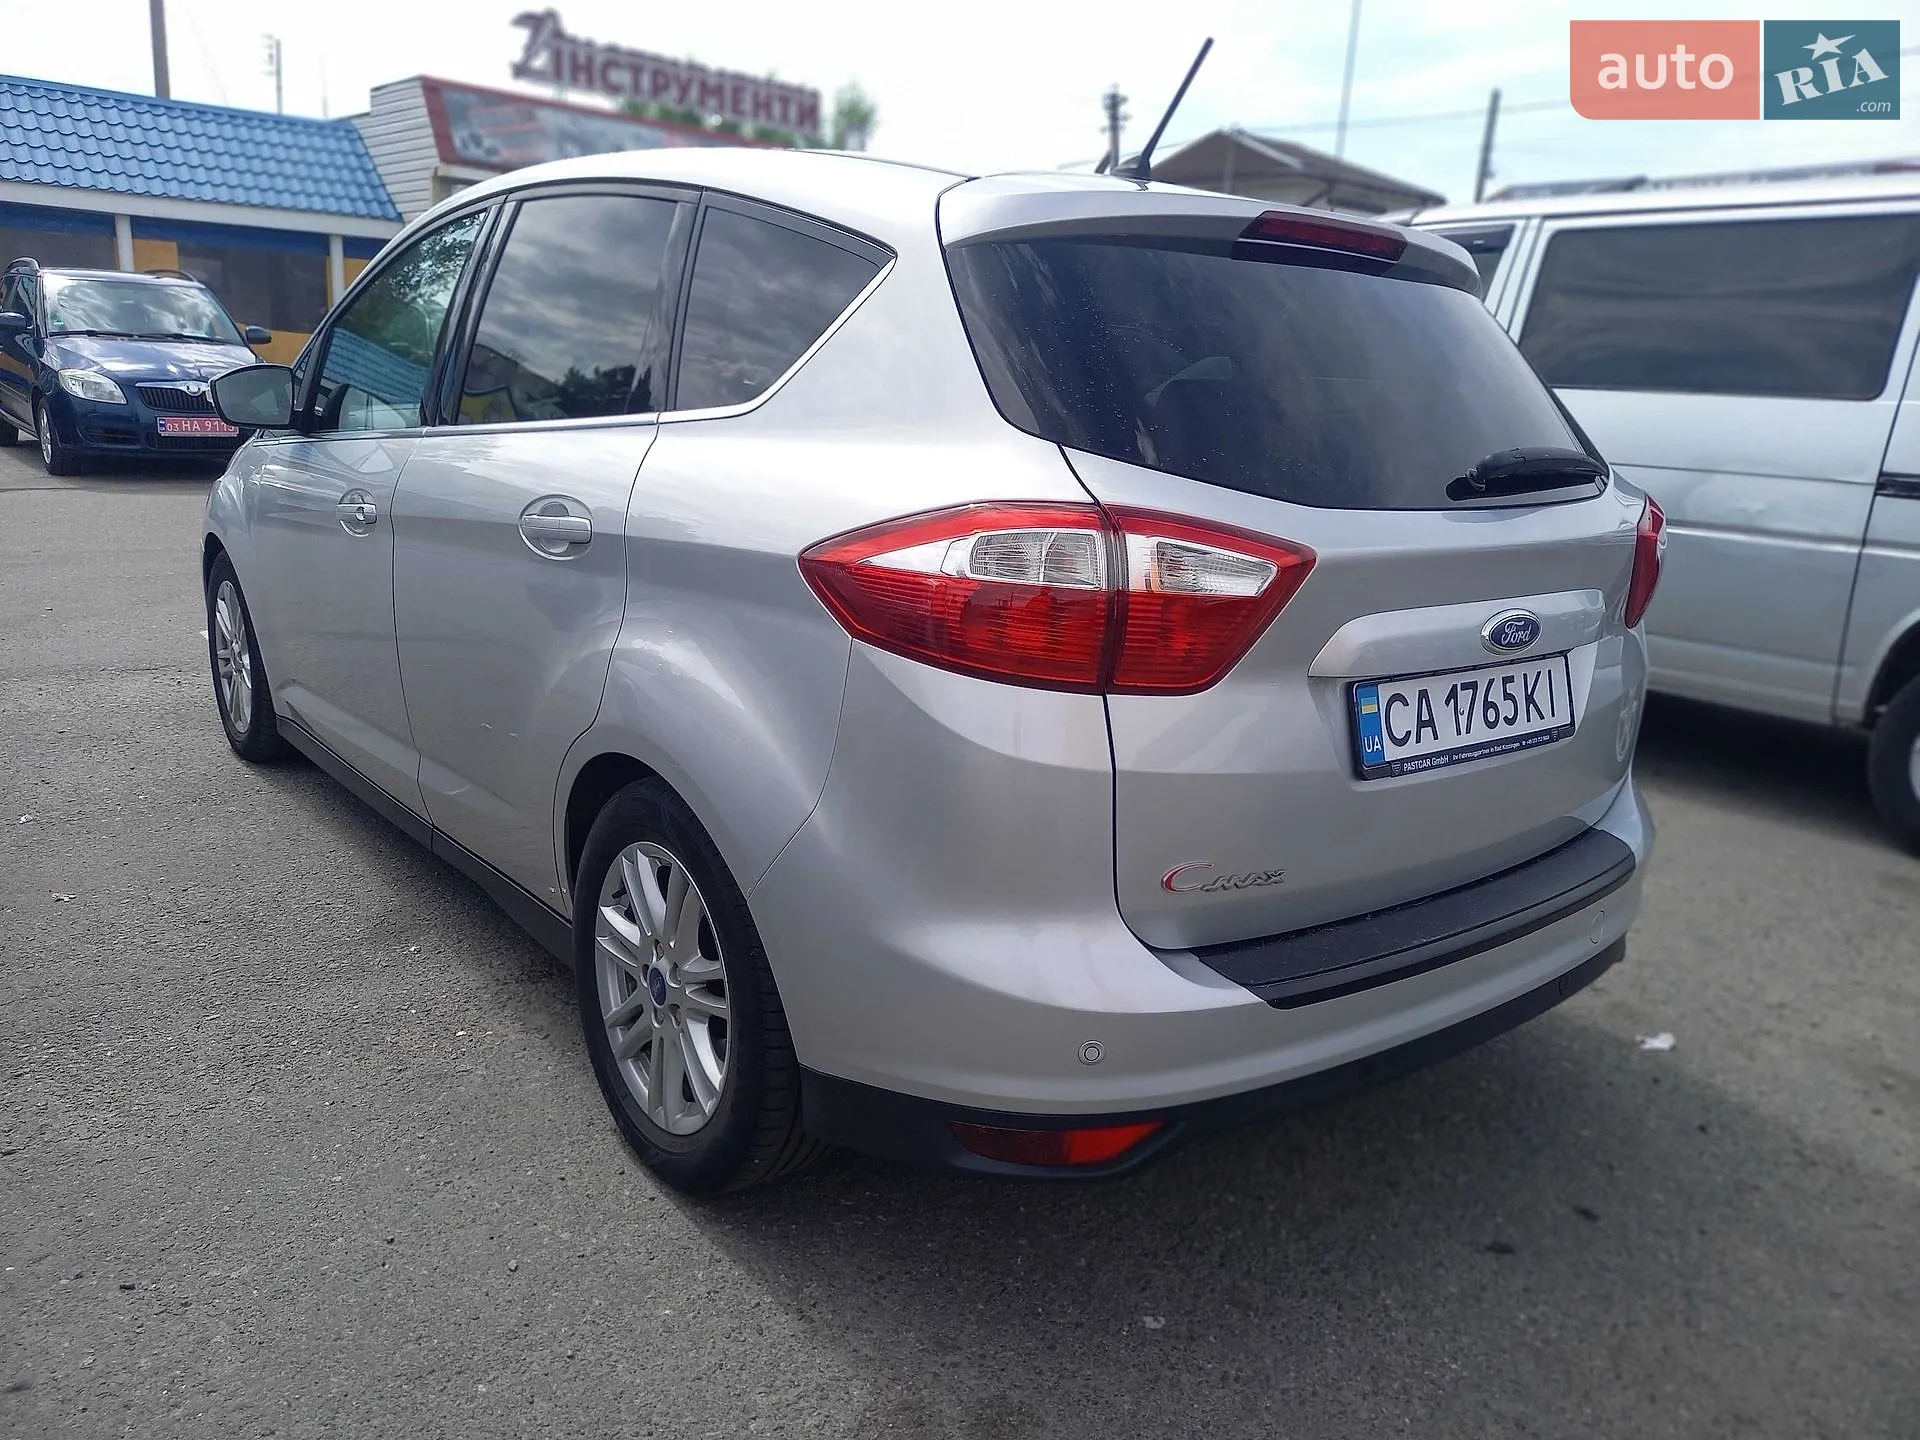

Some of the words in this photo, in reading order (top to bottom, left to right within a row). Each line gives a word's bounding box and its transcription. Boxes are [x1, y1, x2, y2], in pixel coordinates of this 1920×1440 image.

[166, 423, 180, 432] 03
[182, 420, 201, 432] HA
[1501, 620, 1532, 646] Ford
[1384, 688, 1439, 746] CA
[1445, 675, 1518, 735] 1765
[1523, 669, 1555, 723] KI
[1363, 734, 1382, 754] UA
[1403, 757, 1431, 772] PASTCAR
[1431, 754, 1449, 766] GmbH
